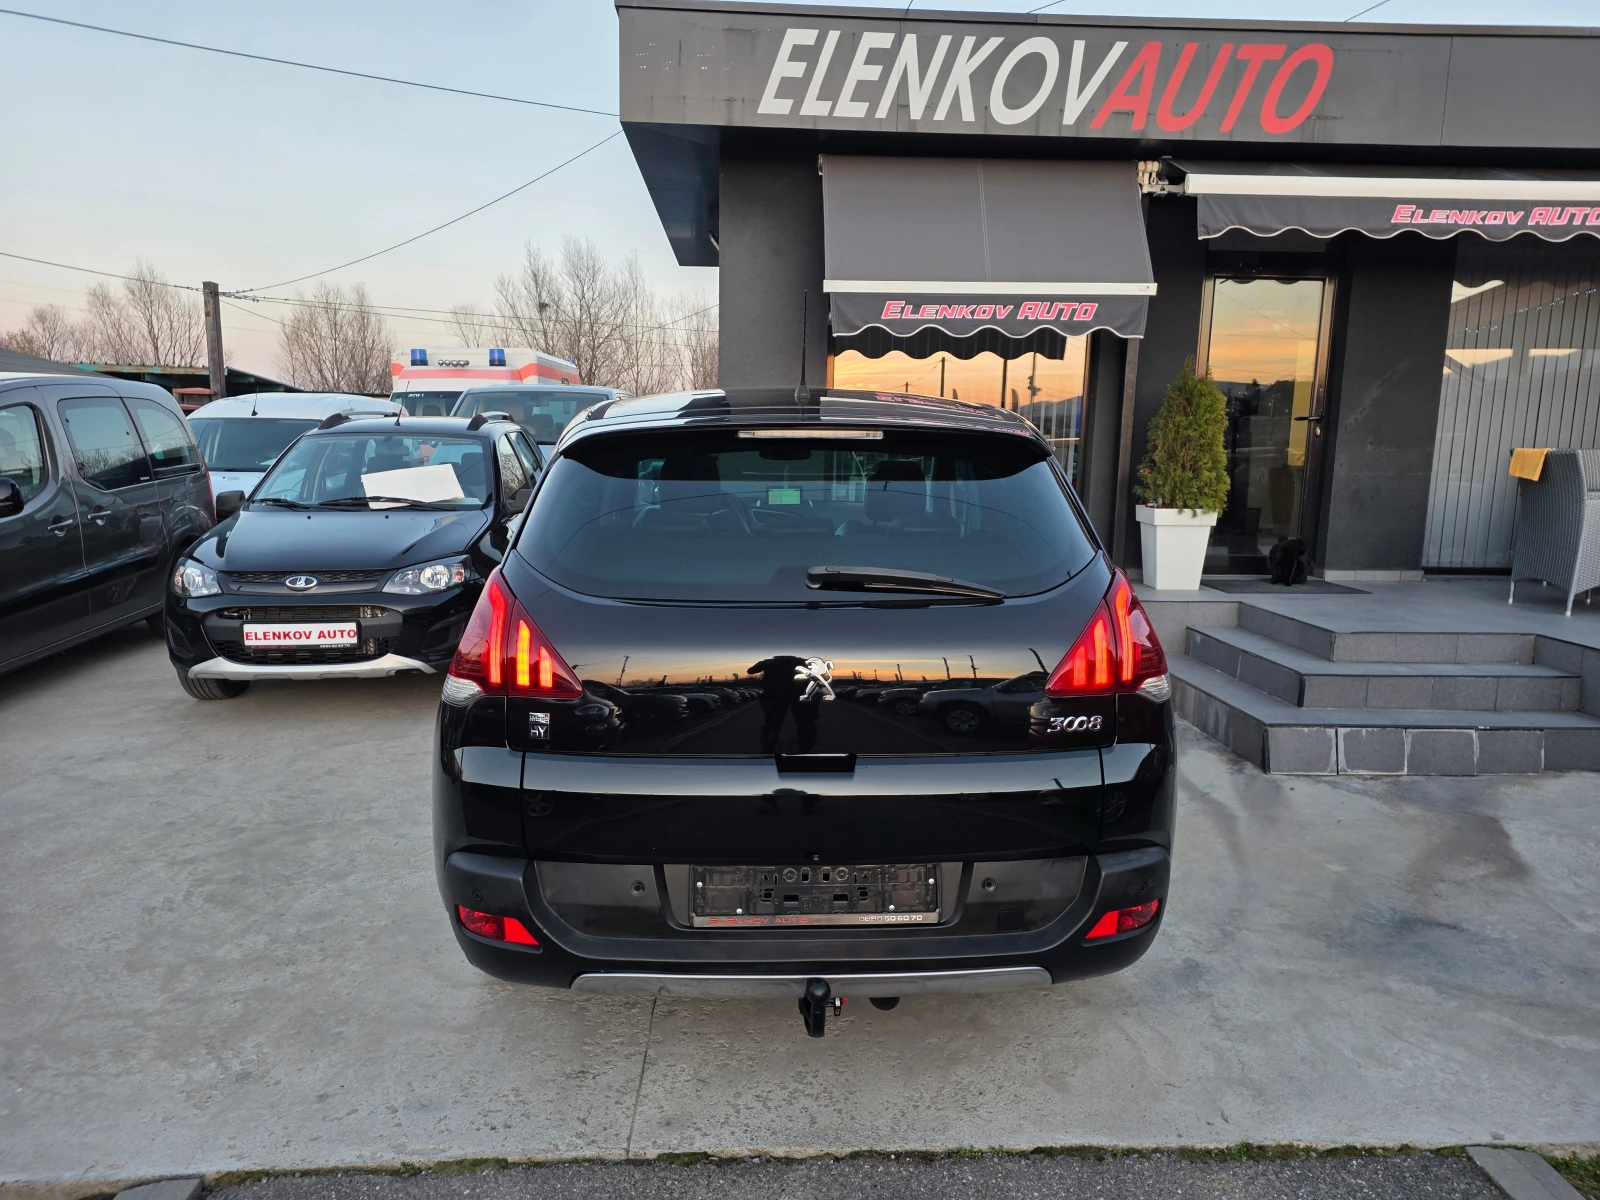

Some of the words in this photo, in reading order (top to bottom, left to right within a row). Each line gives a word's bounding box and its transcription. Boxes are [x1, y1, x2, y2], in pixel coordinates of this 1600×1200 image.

[1391, 204, 1524, 225] ELENKOV
[881, 301, 1014, 319] ELENKOV
[1017, 301, 1099, 321] AUTO
[245, 630, 313, 641] ELENKOV
[317, 629, 358, 640] AUTO
[1046, 715, 1103, 733] 3008
[708, 917, 769, 925] ELENKOV
